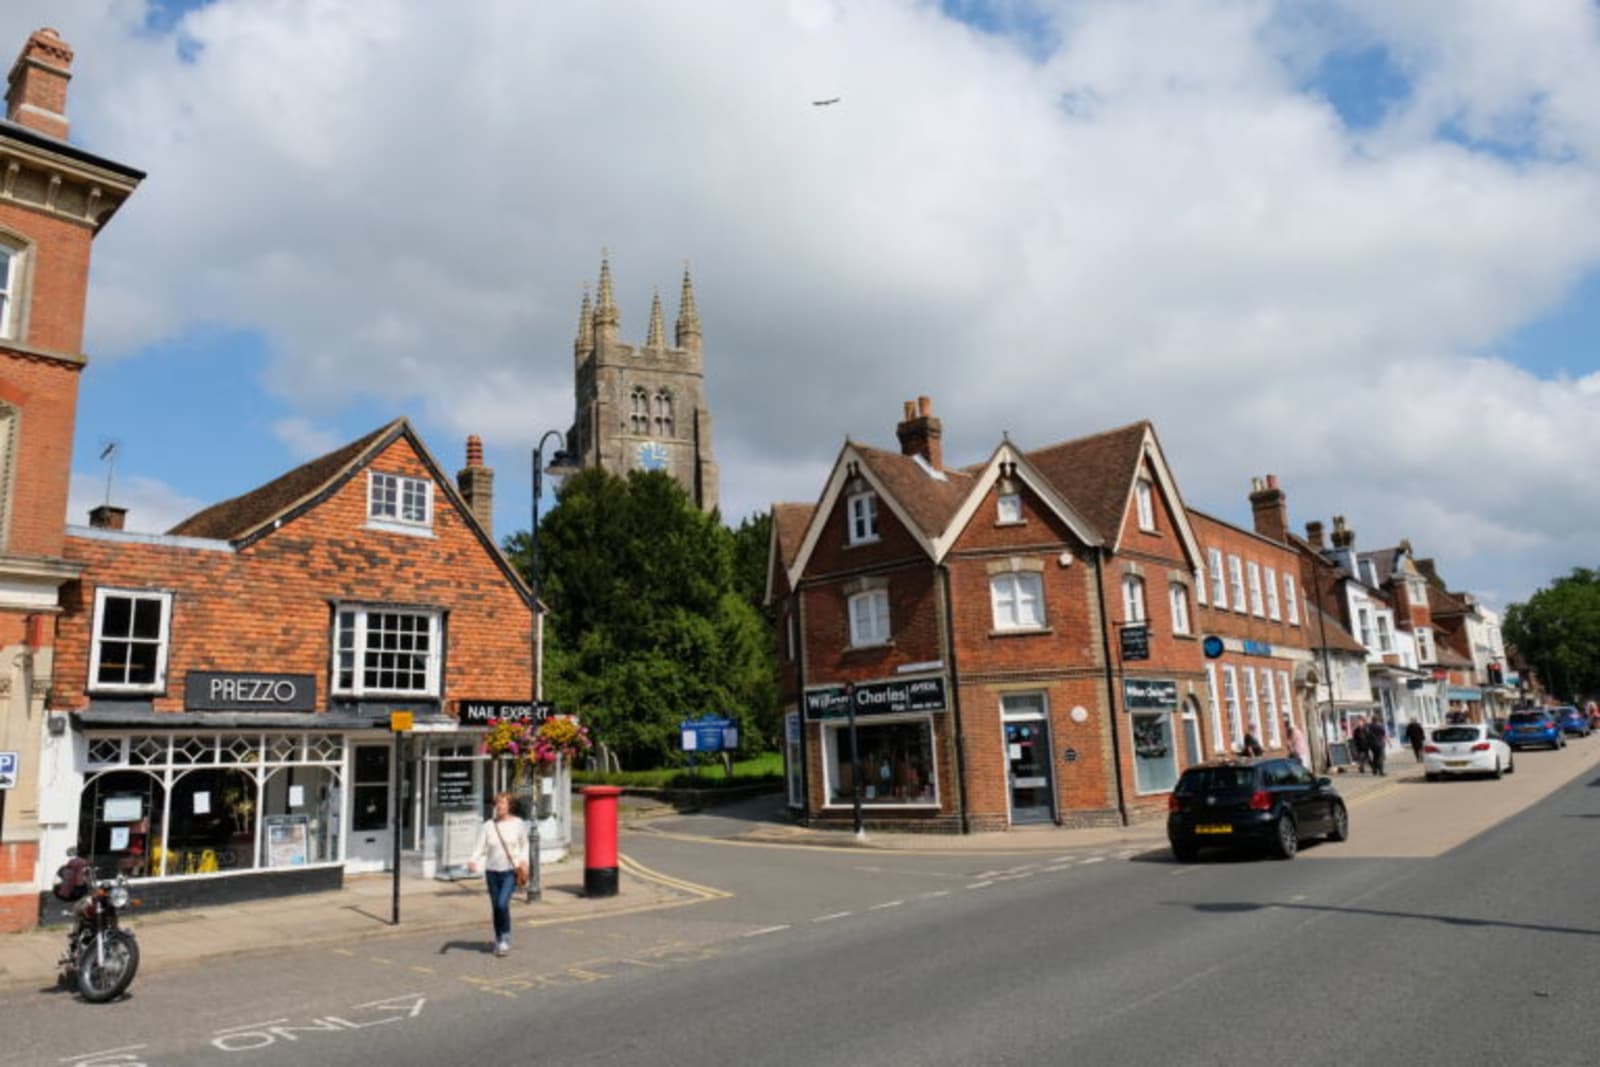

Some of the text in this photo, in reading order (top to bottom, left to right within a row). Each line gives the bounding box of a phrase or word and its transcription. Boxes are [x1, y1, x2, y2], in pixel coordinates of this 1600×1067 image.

[210, 679, 297, 702] PREZZO
[856, 686, 905, 705] Charles
[467, 704, 495, 720] NAIL
[211, 996, 427, 1051] ONLY
